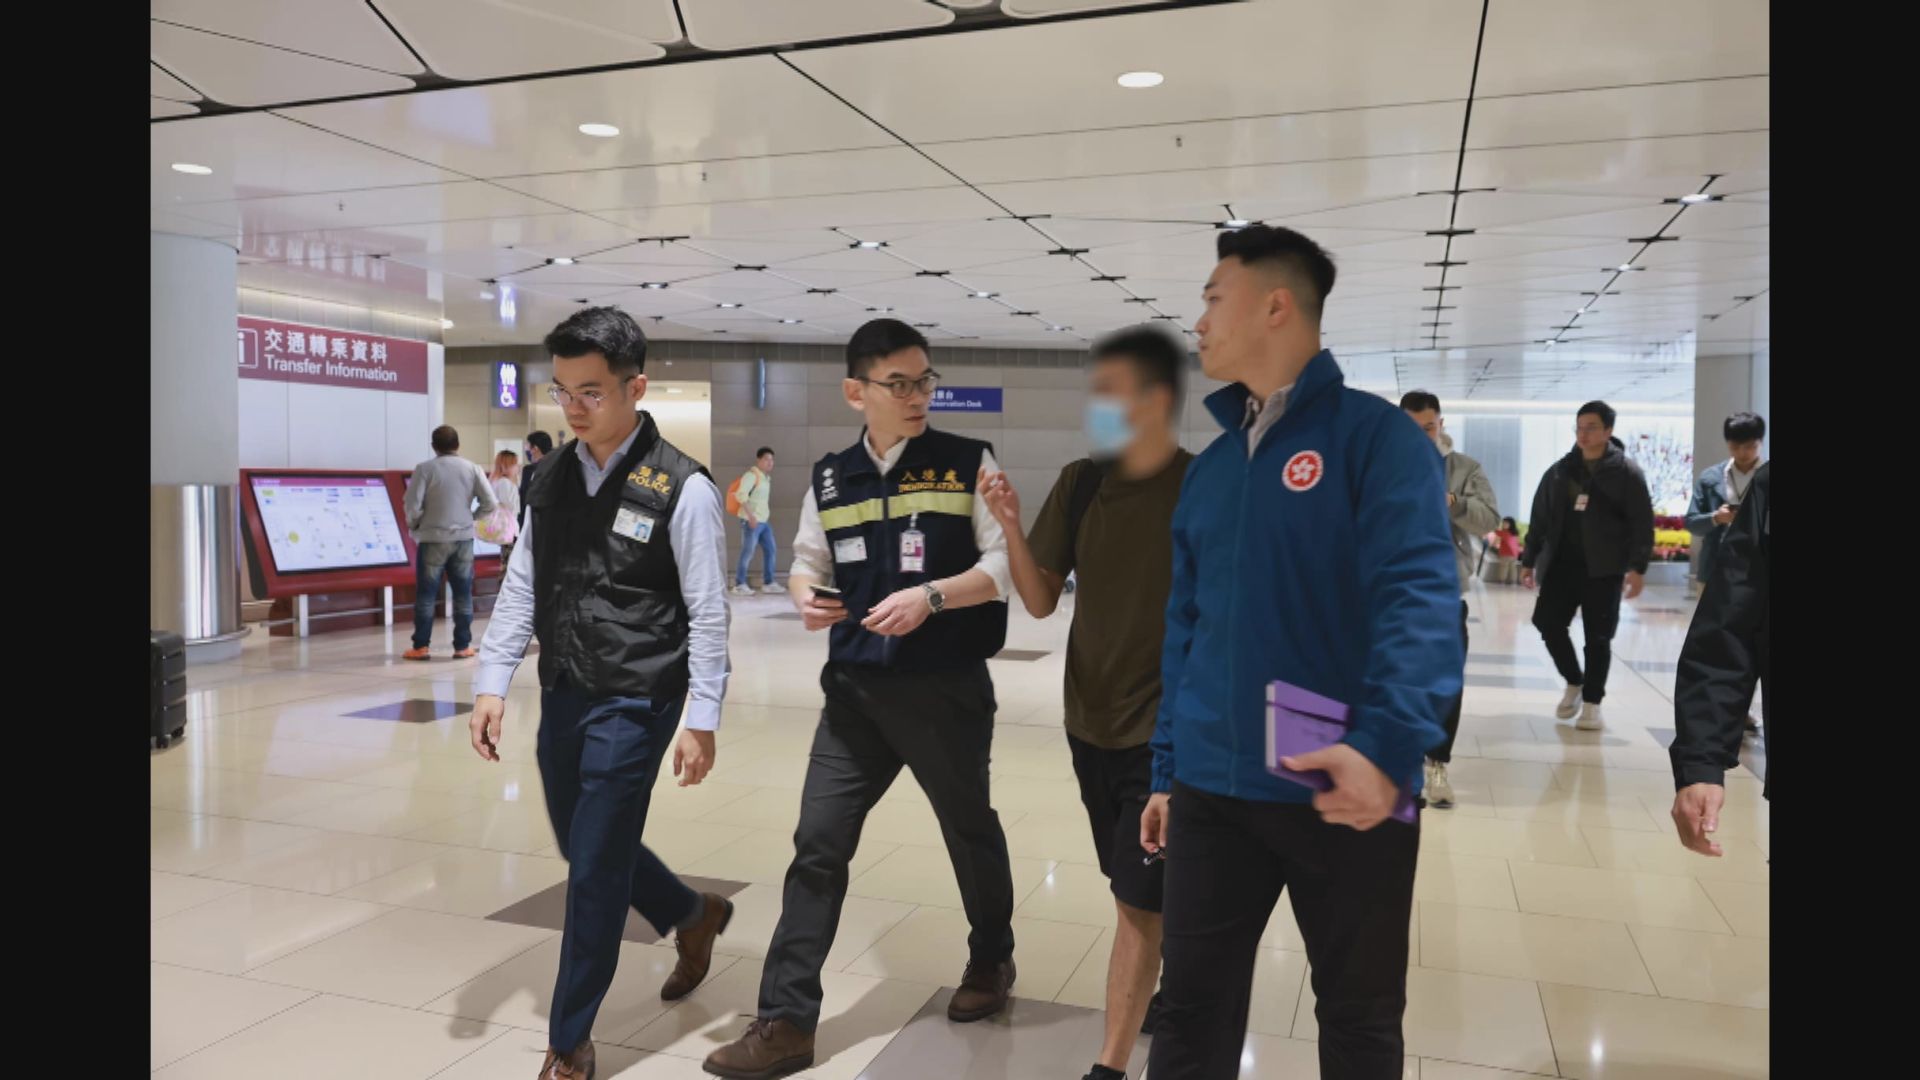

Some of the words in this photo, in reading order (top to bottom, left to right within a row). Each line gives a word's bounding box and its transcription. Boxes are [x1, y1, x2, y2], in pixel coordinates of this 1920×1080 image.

[264, 328, 388, 364] 交通轉乘資料
[264, 354, 321, 375] Transfer
[326, 360, 398, 383] Information
[627, 472, 671, 495] POLICE
